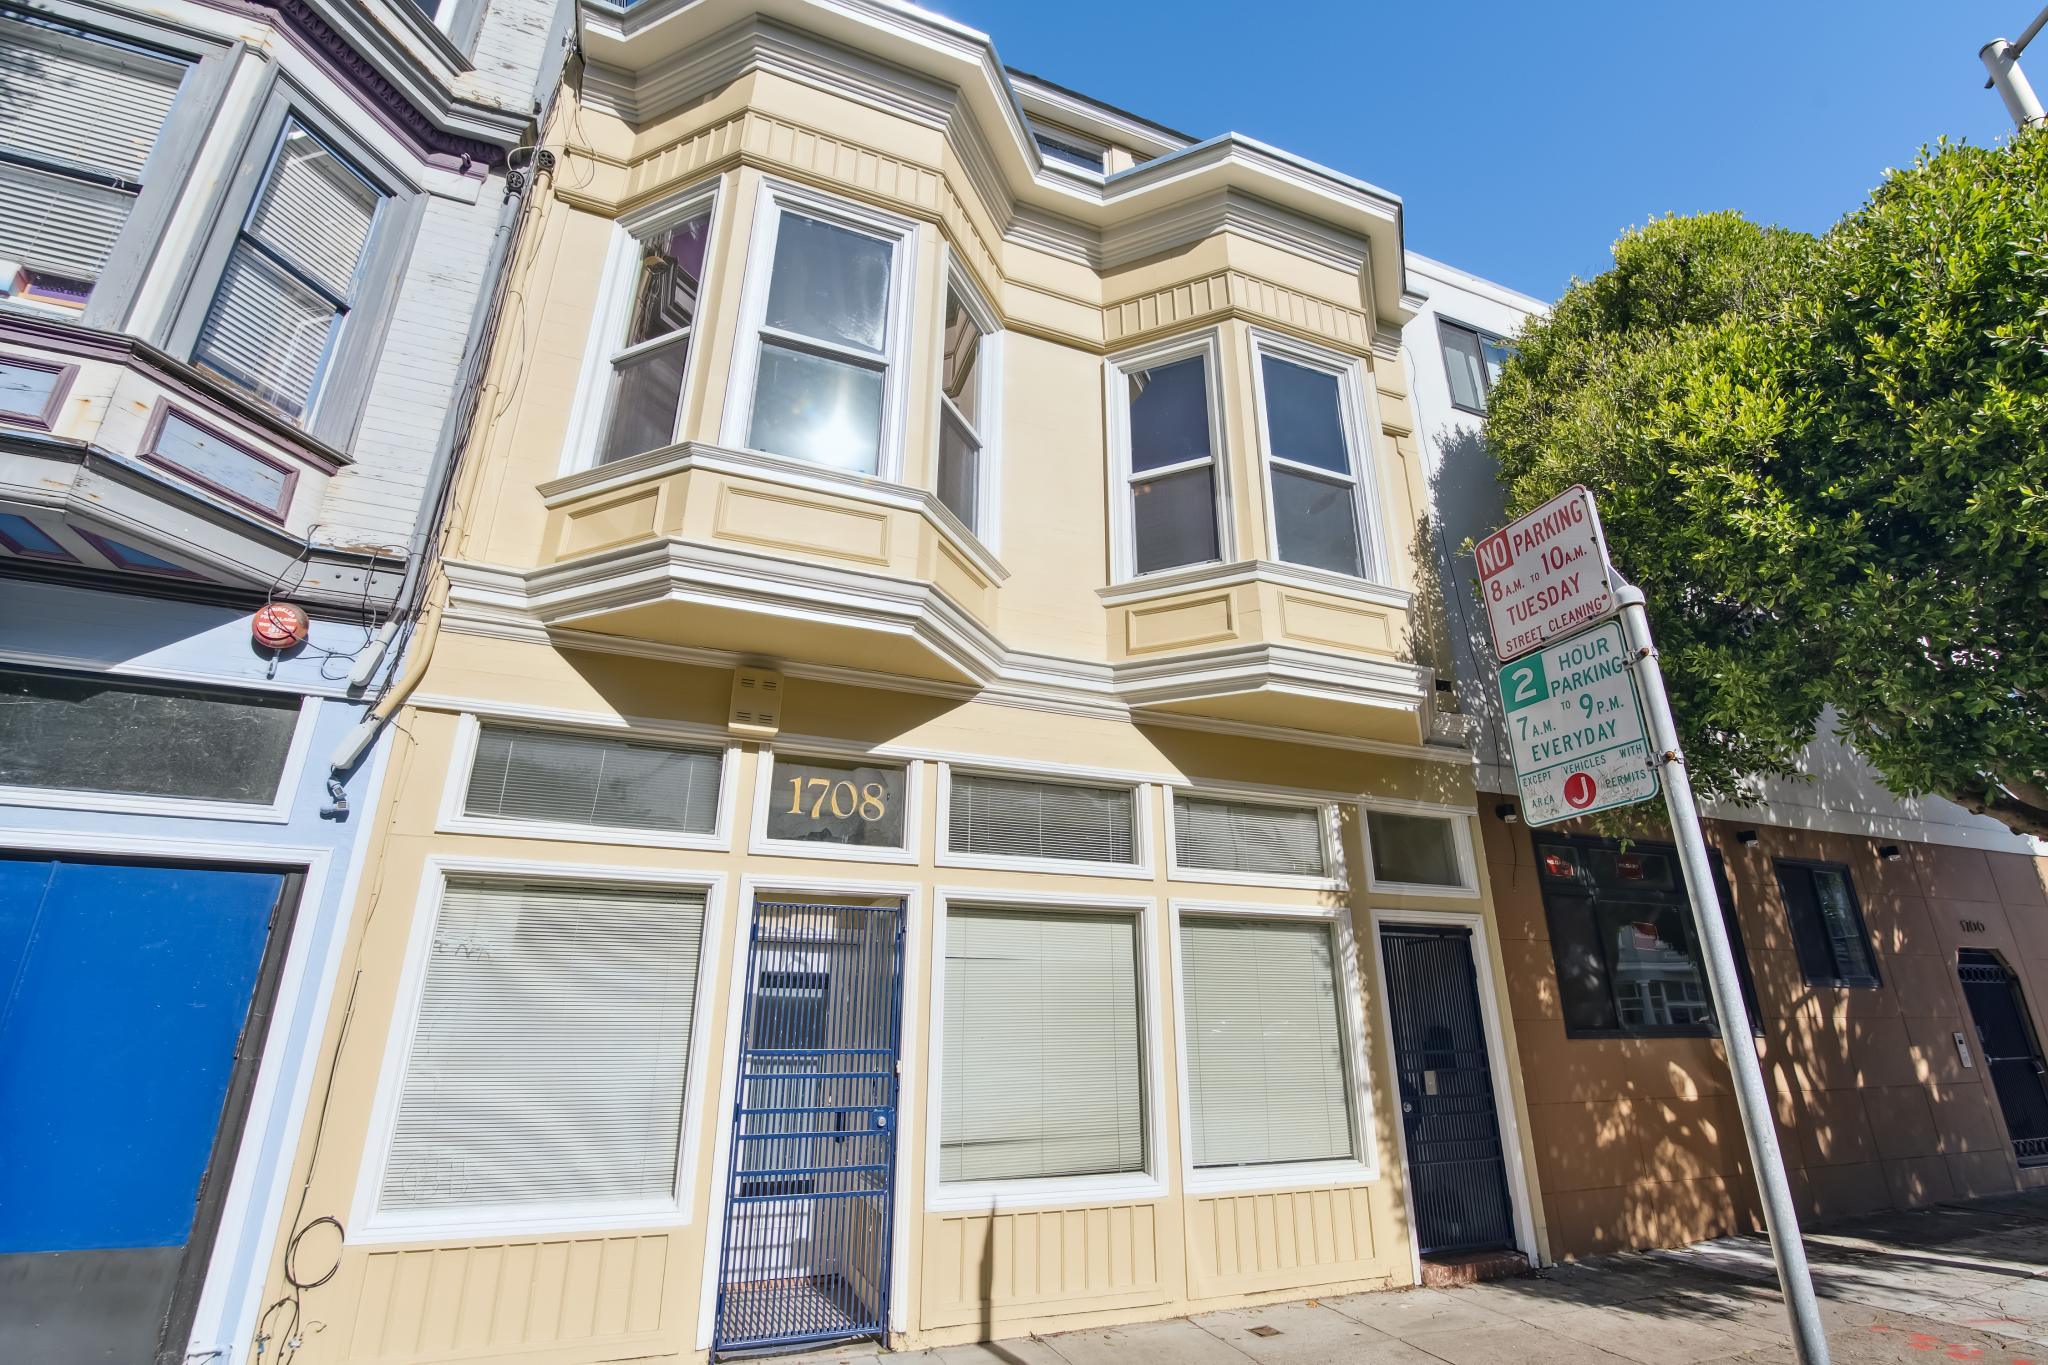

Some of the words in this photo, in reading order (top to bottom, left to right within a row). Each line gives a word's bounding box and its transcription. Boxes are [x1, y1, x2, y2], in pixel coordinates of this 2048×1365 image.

[1480, 537, 1508, 576] NO
[1513, 500, 1583, 557] PARKING
[1491, 580, 1502, 602] 8
[1505, 578, 1525, 597] A.M.
[1530, 572, 1540, 583] TO
[1541, 545, 1564, 575] 10
[1565, 545, 1587, 565] A.M.
[1506, 572, 1580, 626] TUESDAY
[1506, 625, 1543, 653] STREET
[1548, 597, 1602, 632] CLEANING
[1558, 637, 1610, 671] HOUR
[1511, 667, 1537, 703] 2
[1551, 656, 1623, 698] PARKING
[1516, 716, 1528, 741] 7
[1532, 719, 1556, 738] A.M.
[1560, 700, 1571, 711] TO
[1579, 693, 1593, 719] 9
[1597, 695, 1625, 715] P.M.
[1532, 719, 1616, 762] EVERYDAY
[1522, 770, 1551, 788] EXCEPT
[1563, 755, 1606, 776] VEHICLES
[1619, 743, 1643, 759] WITH
[785, 776, 886, 822] 1708
[1532, 795, 1555, 809] AREA
[1572, 776, 1589, 804] J
[1605, 769, 1647, 789] PERMITS
